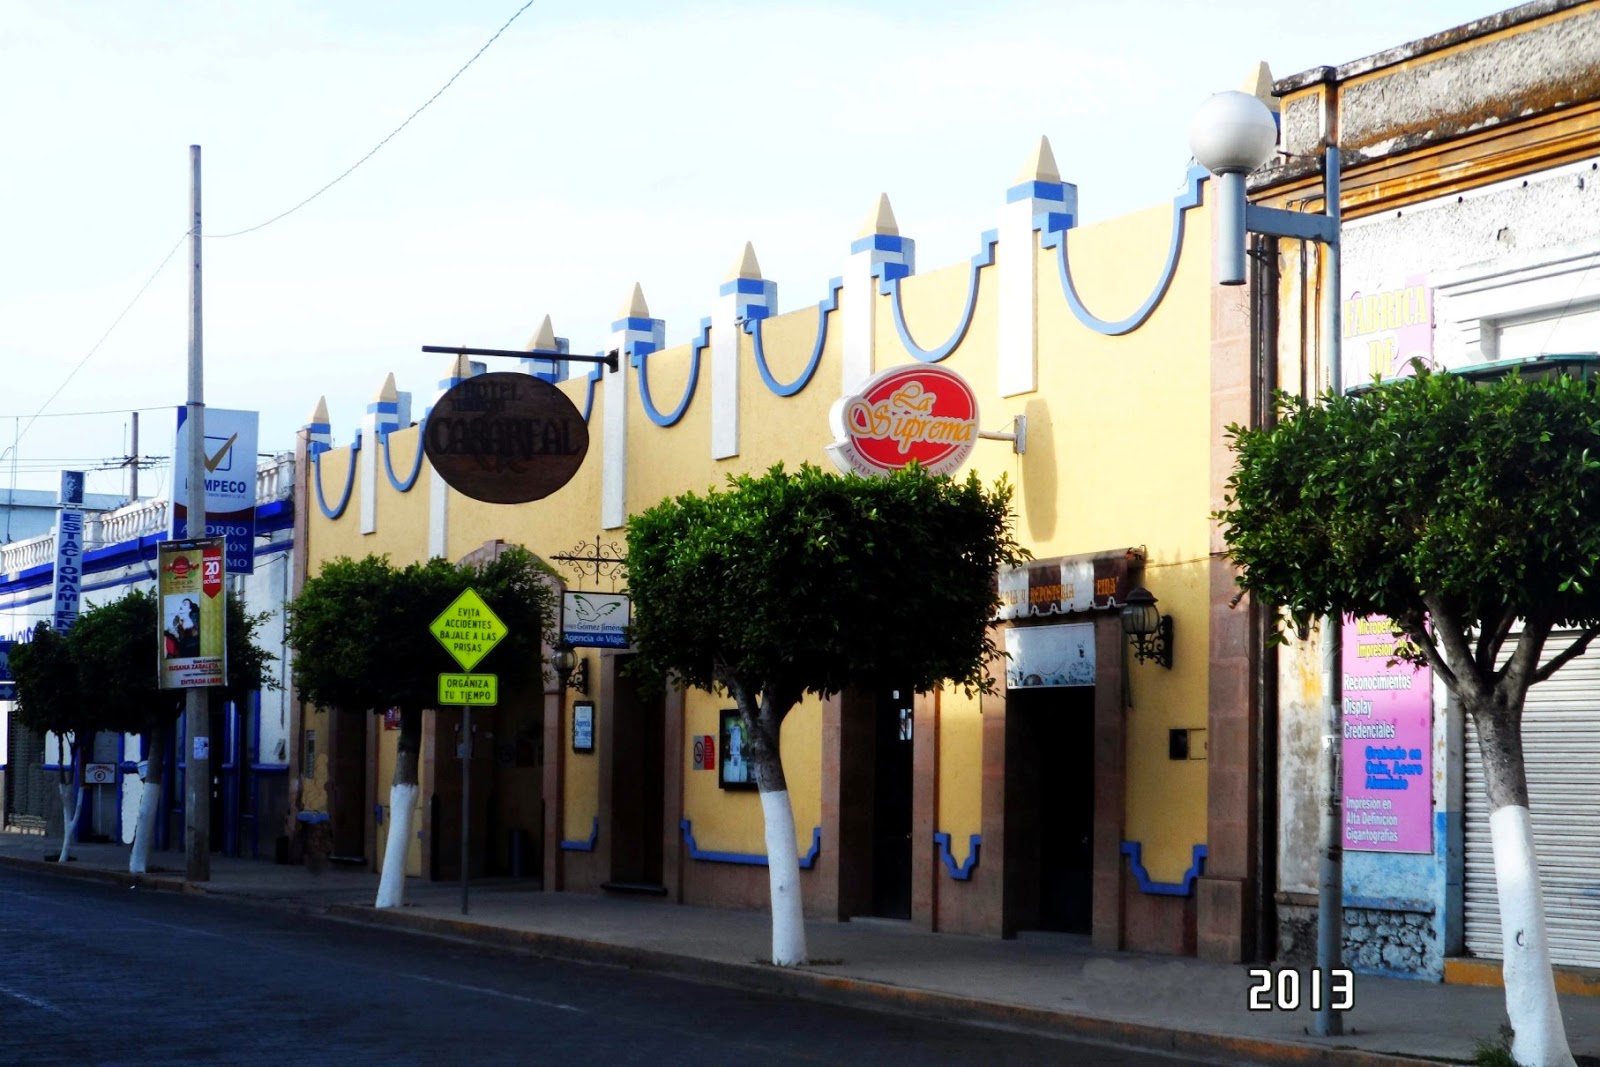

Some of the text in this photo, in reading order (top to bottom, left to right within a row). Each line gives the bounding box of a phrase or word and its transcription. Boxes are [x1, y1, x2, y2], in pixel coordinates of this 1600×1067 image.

[1343, 285, 1428, 338] FABRICA
[1368, 337, 1394, 380] DE
[893, 384, 936, 411] La
[848, 402, 975, 450] Suprema
[185, 477, 246, 494] MPECO
[180, 525, 248, 536] AORRO
[204, 561, 220, 575] 20
[458, 608, 480, 617] EVITA
[445, 619, 492, 629] ACCIDENTES
[439, 630, 470, 640] BAJALE
[481, 632, 497, 641] LAS
[605, 635, 625, 645] Viaje
[453, 643, 482, 653] PRISAS
[446, 679, 489, 688] ORGANIZA
[1343, 672, 1413, 691] Reconocimientos
[444, 691, 491, 700] TU TIEMPO
[1343, 697, 1373, 718] Display
[1343, 720, 1396, 739] Credenciales
